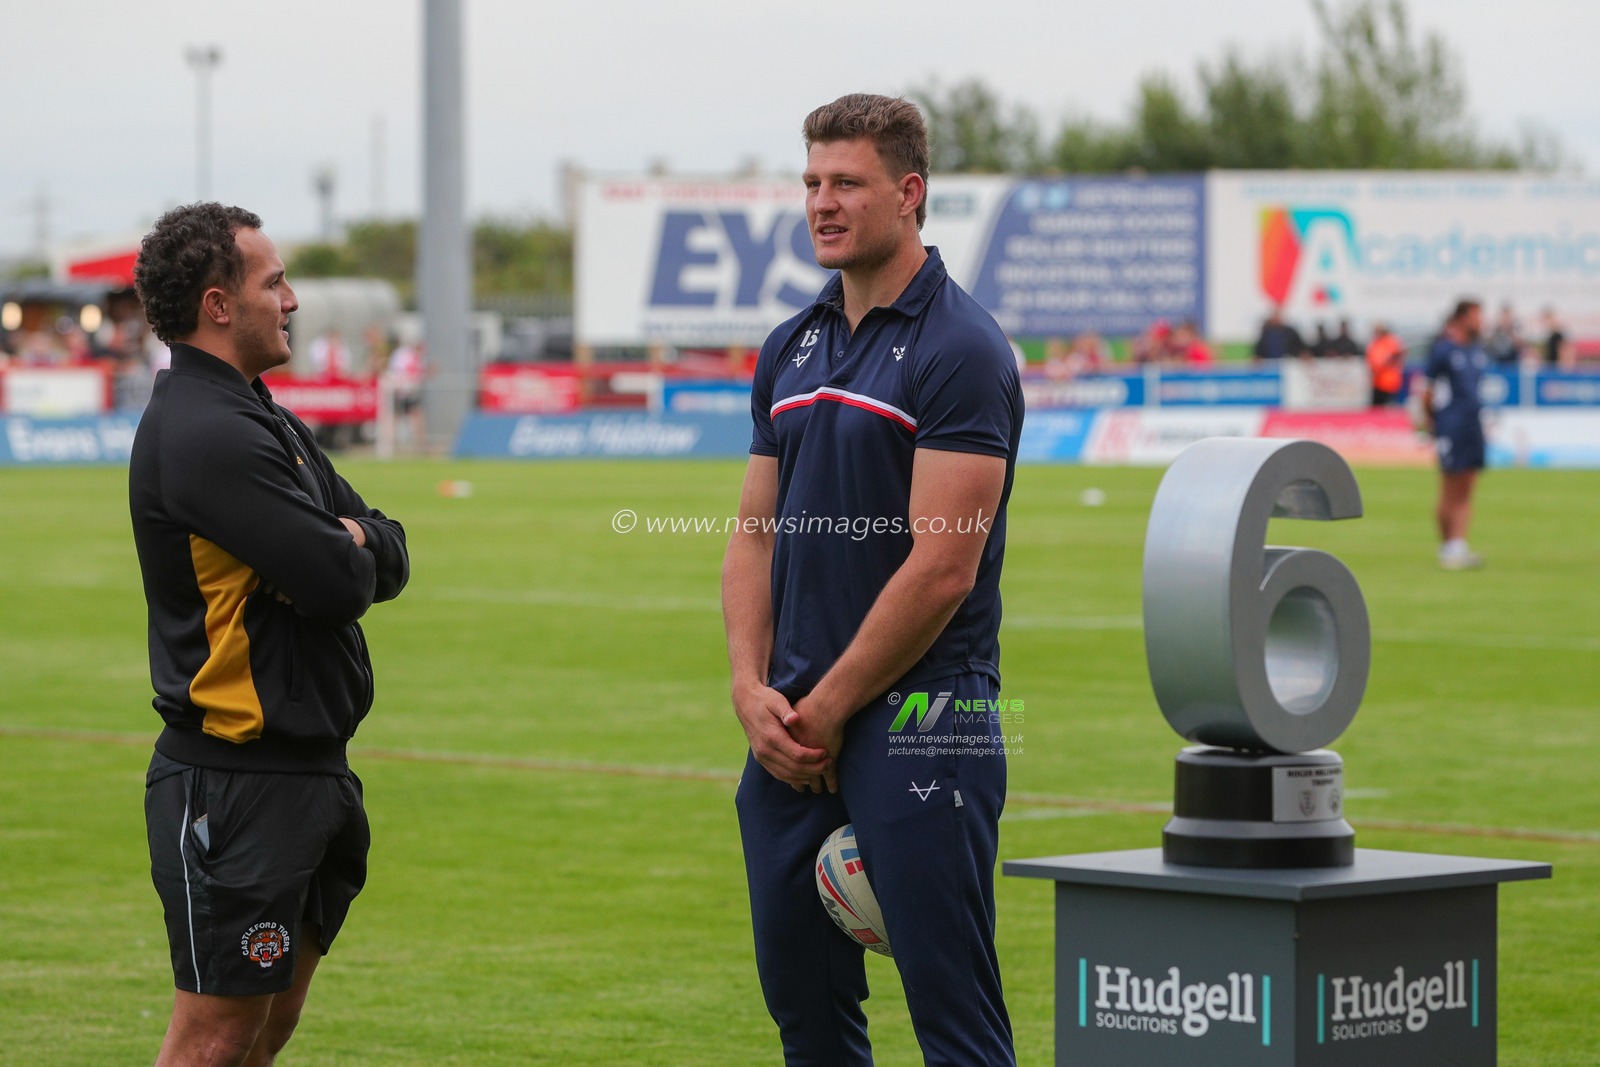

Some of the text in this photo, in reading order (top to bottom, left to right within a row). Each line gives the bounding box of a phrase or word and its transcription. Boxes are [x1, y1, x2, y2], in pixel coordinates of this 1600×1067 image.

[800, 329, 820, 348] 15
[241, 922, 290, 956] CASTLEFORD TIGERS
[1095, 964, 1257, 1037] Hudgell
[1331, 960, 1467, 1032] Hudgell
[1096, 1012, 1178, 1035] SOLICITORS
[1332, 1019, 1402, 1041] SOLICITORS
